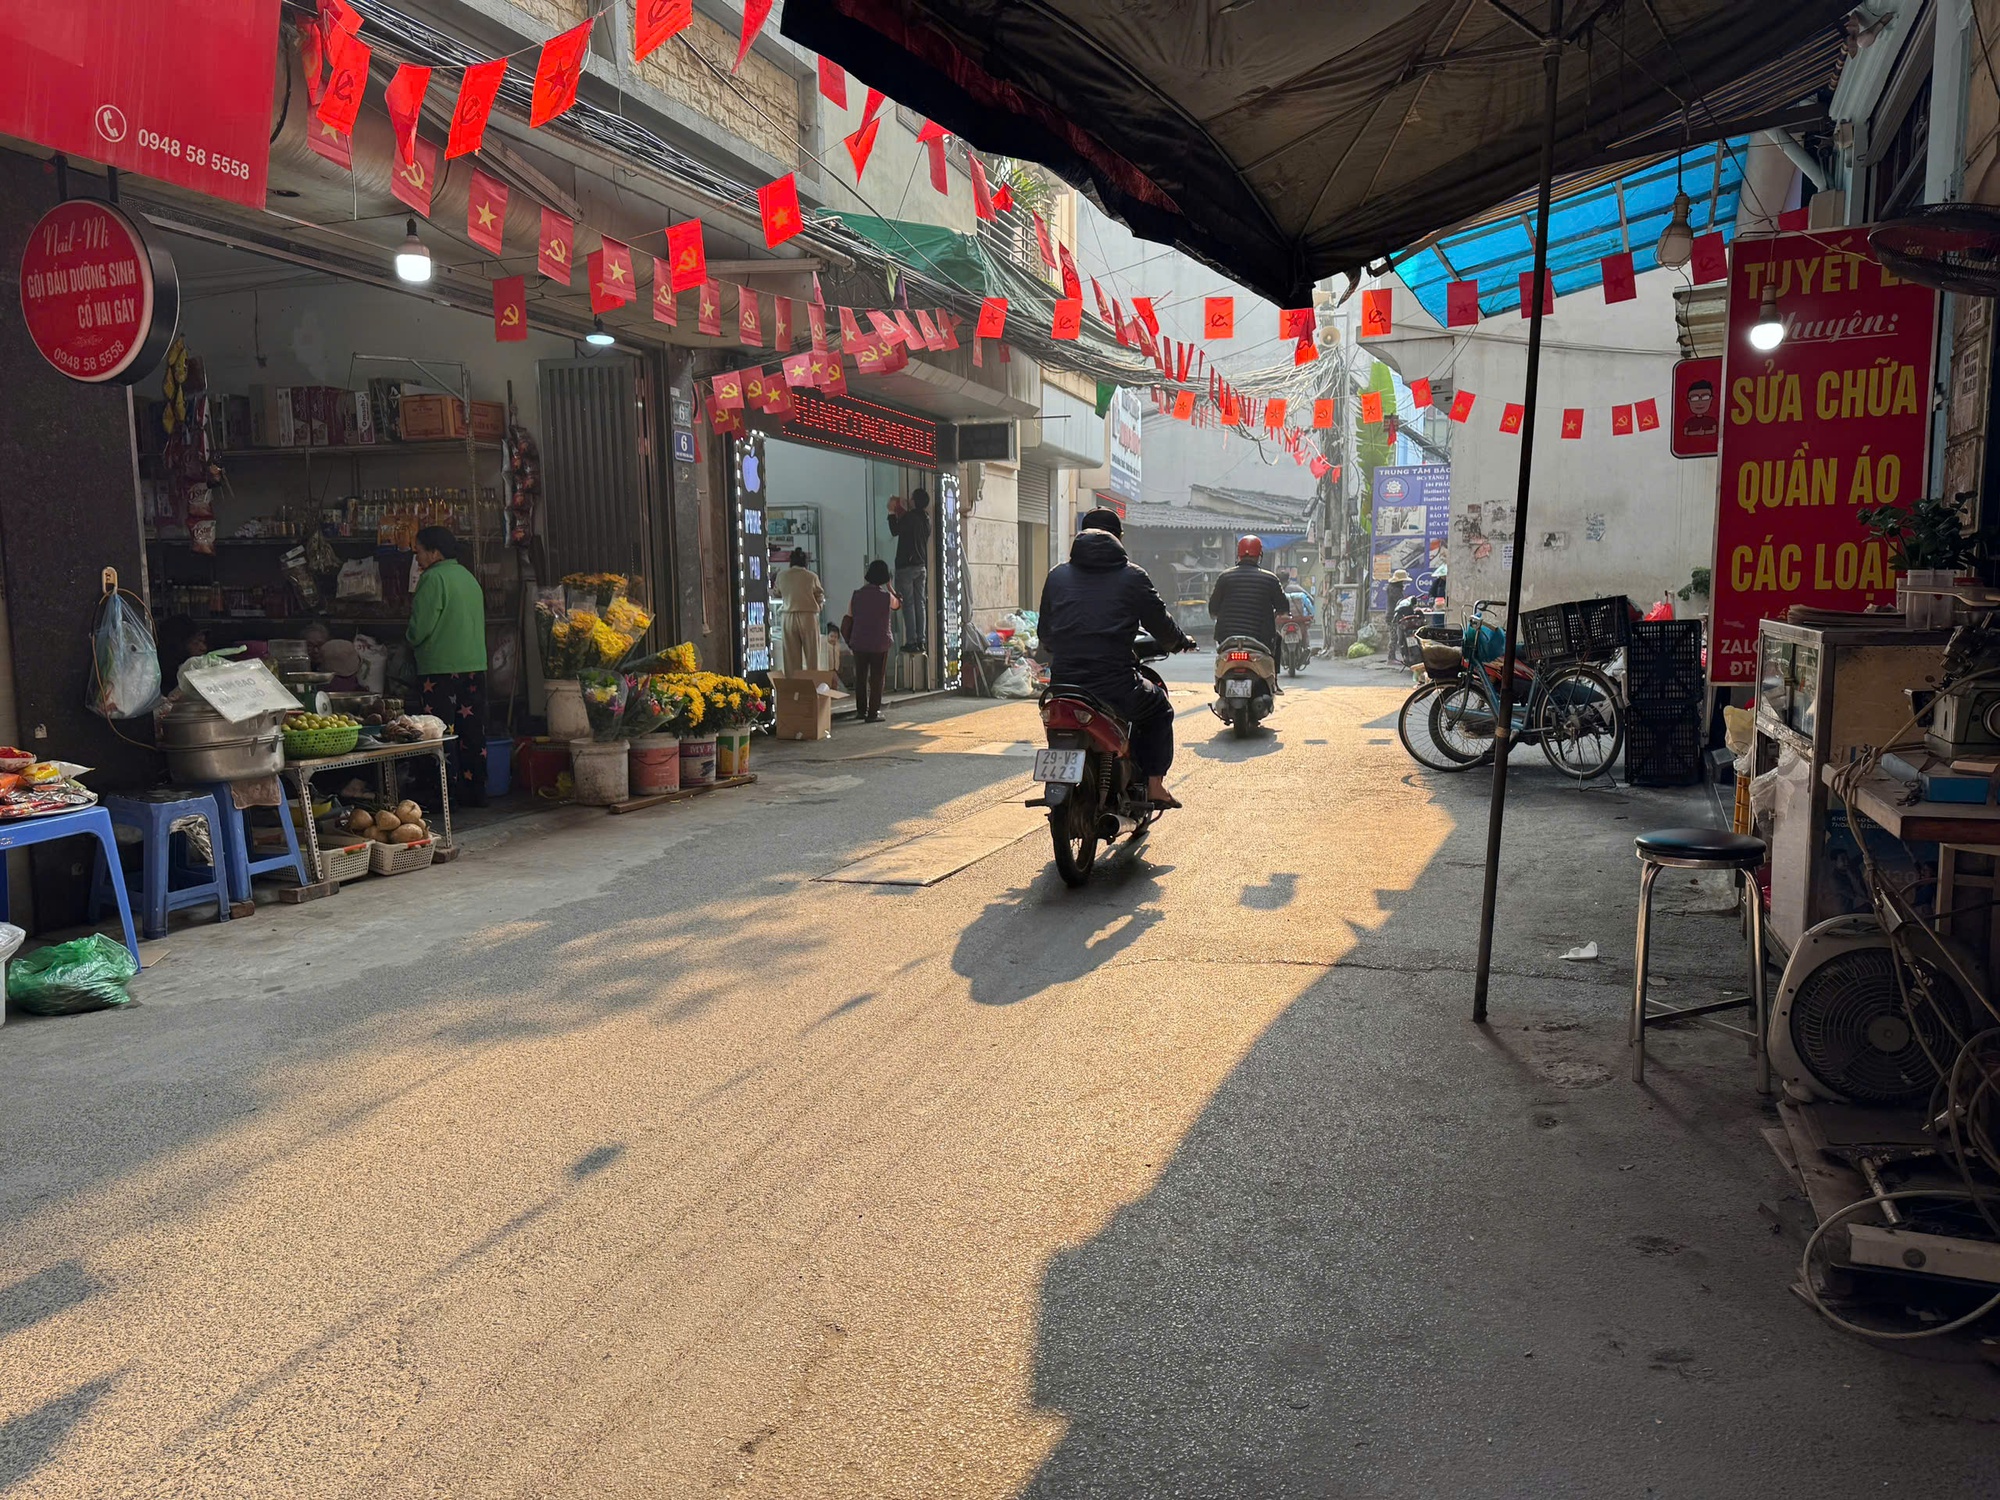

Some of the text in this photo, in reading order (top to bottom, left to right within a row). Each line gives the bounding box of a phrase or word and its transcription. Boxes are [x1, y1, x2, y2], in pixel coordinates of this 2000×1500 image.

[138, 129, 250, 180] 0948 58 5558
[109, 259, 137, 287] SINH
[1744, 236, 1866, 299] TUYẾT
[94, 301, 112, 326] VAI
[114, 294, 136, 325] GÁY
[1779, 310, 1899, 343] huyên:
[53, 339, 125, 371] 0948 58 5558
[1730, 357, 1918, 425] SỬA CHỮA
[680, 434, 689, 452] 6
[1737, 441, 1901, 514] QUẦN ÁO
[1731, 534, 1802, 592] CÁC
[1729, 660, 1756, 676] ĐT:
